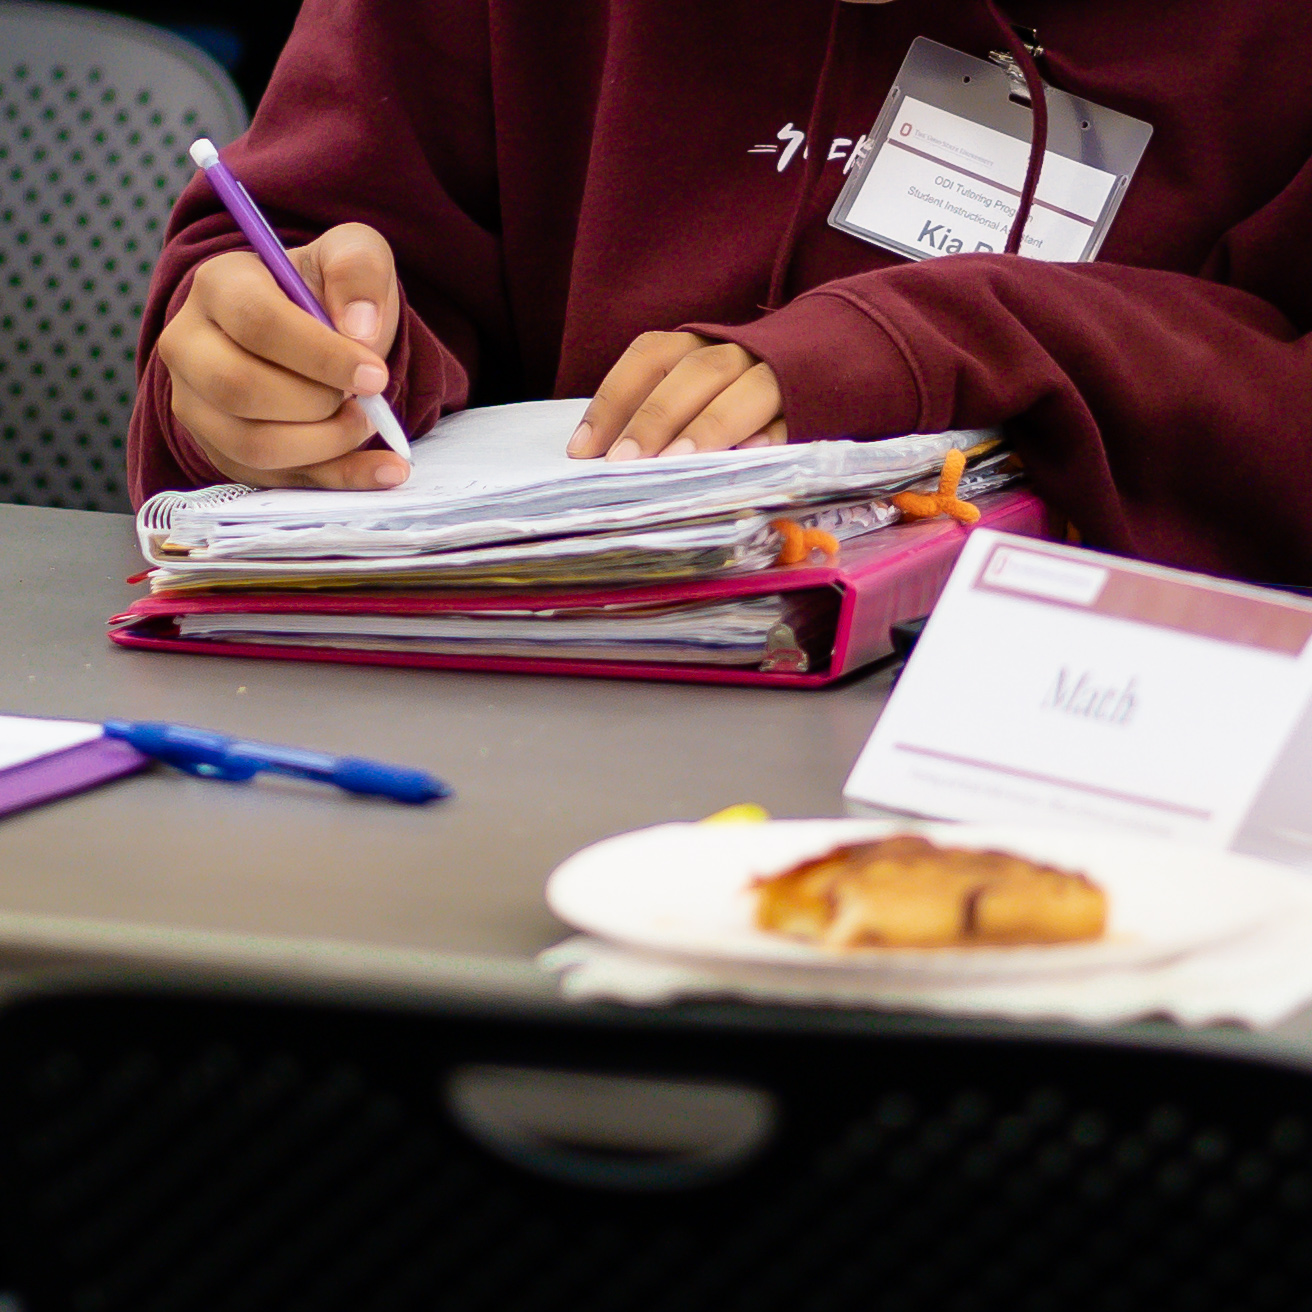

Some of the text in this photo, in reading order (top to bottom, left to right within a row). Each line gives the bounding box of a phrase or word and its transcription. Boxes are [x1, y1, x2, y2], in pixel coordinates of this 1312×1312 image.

[907, 185, 944, 208] Student
[944, 201, 999, 230] Instructional
[934, 175, 1034, 224] ODI Tutoring Progm
[916, 219, 964, 255] Kia
